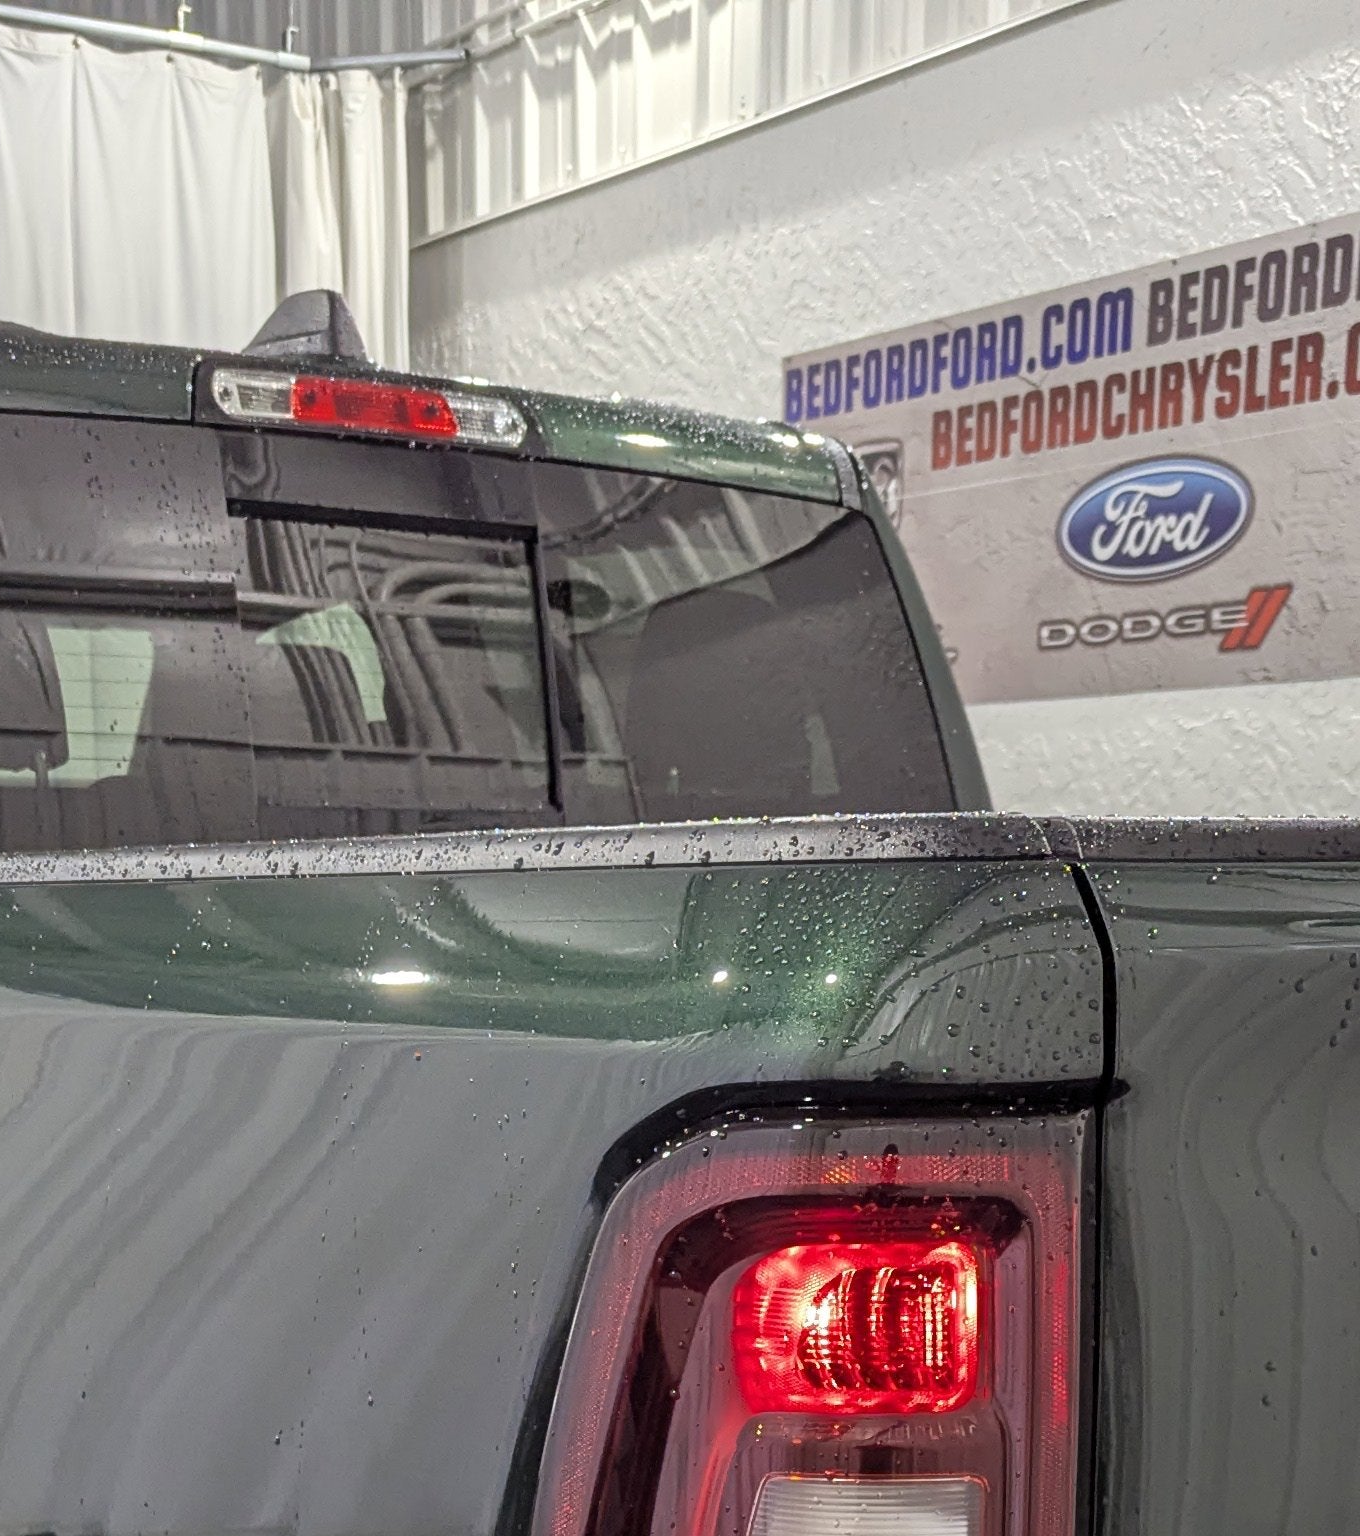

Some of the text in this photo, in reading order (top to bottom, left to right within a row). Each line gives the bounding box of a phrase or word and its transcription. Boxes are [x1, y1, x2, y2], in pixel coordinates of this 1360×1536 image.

[784, 286, 1134, 422] BEDFORDFORD.COM
[1091, 479, 1215, 561] Ford
[1037, 600, 1250, 649] DODGE
